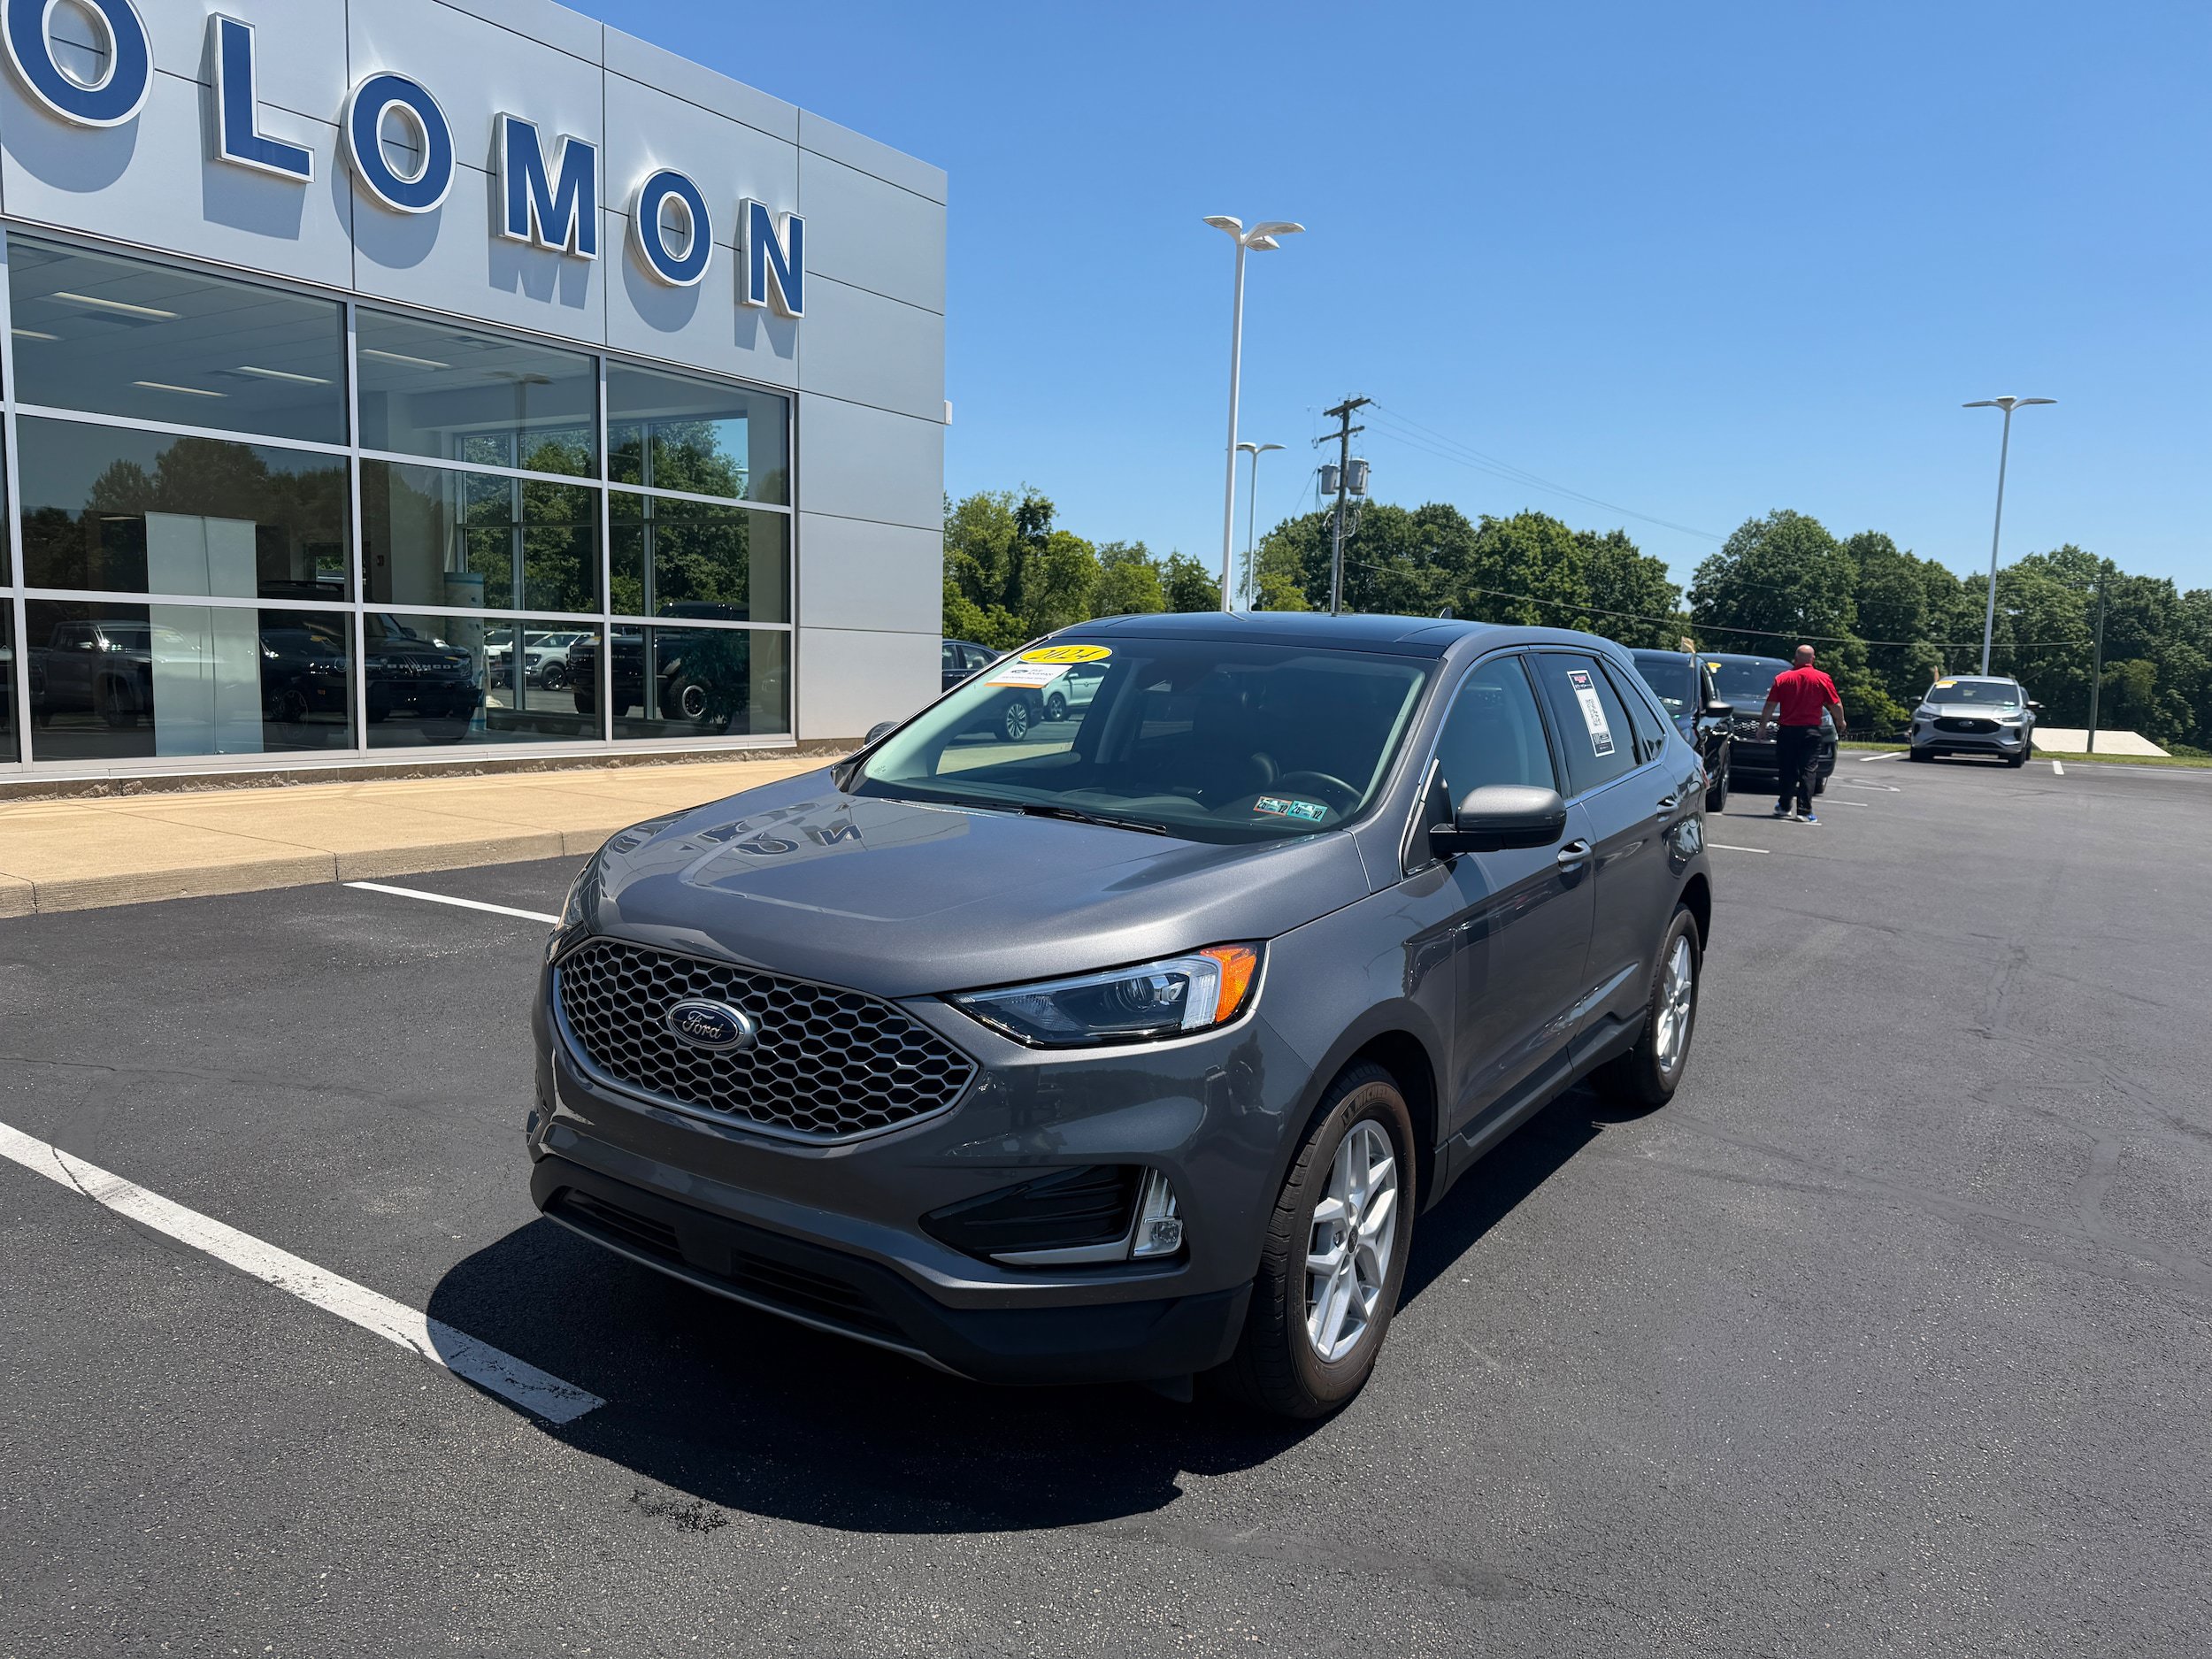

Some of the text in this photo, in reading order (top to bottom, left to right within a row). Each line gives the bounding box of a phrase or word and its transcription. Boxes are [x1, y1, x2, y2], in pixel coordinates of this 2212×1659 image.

[0, 0, 807, 320] OLOMON
[1278, 804, 1288, 814] 12
[1312, 810, 1323, 819] 12
[682, 1010, 724, 1040] Ford
